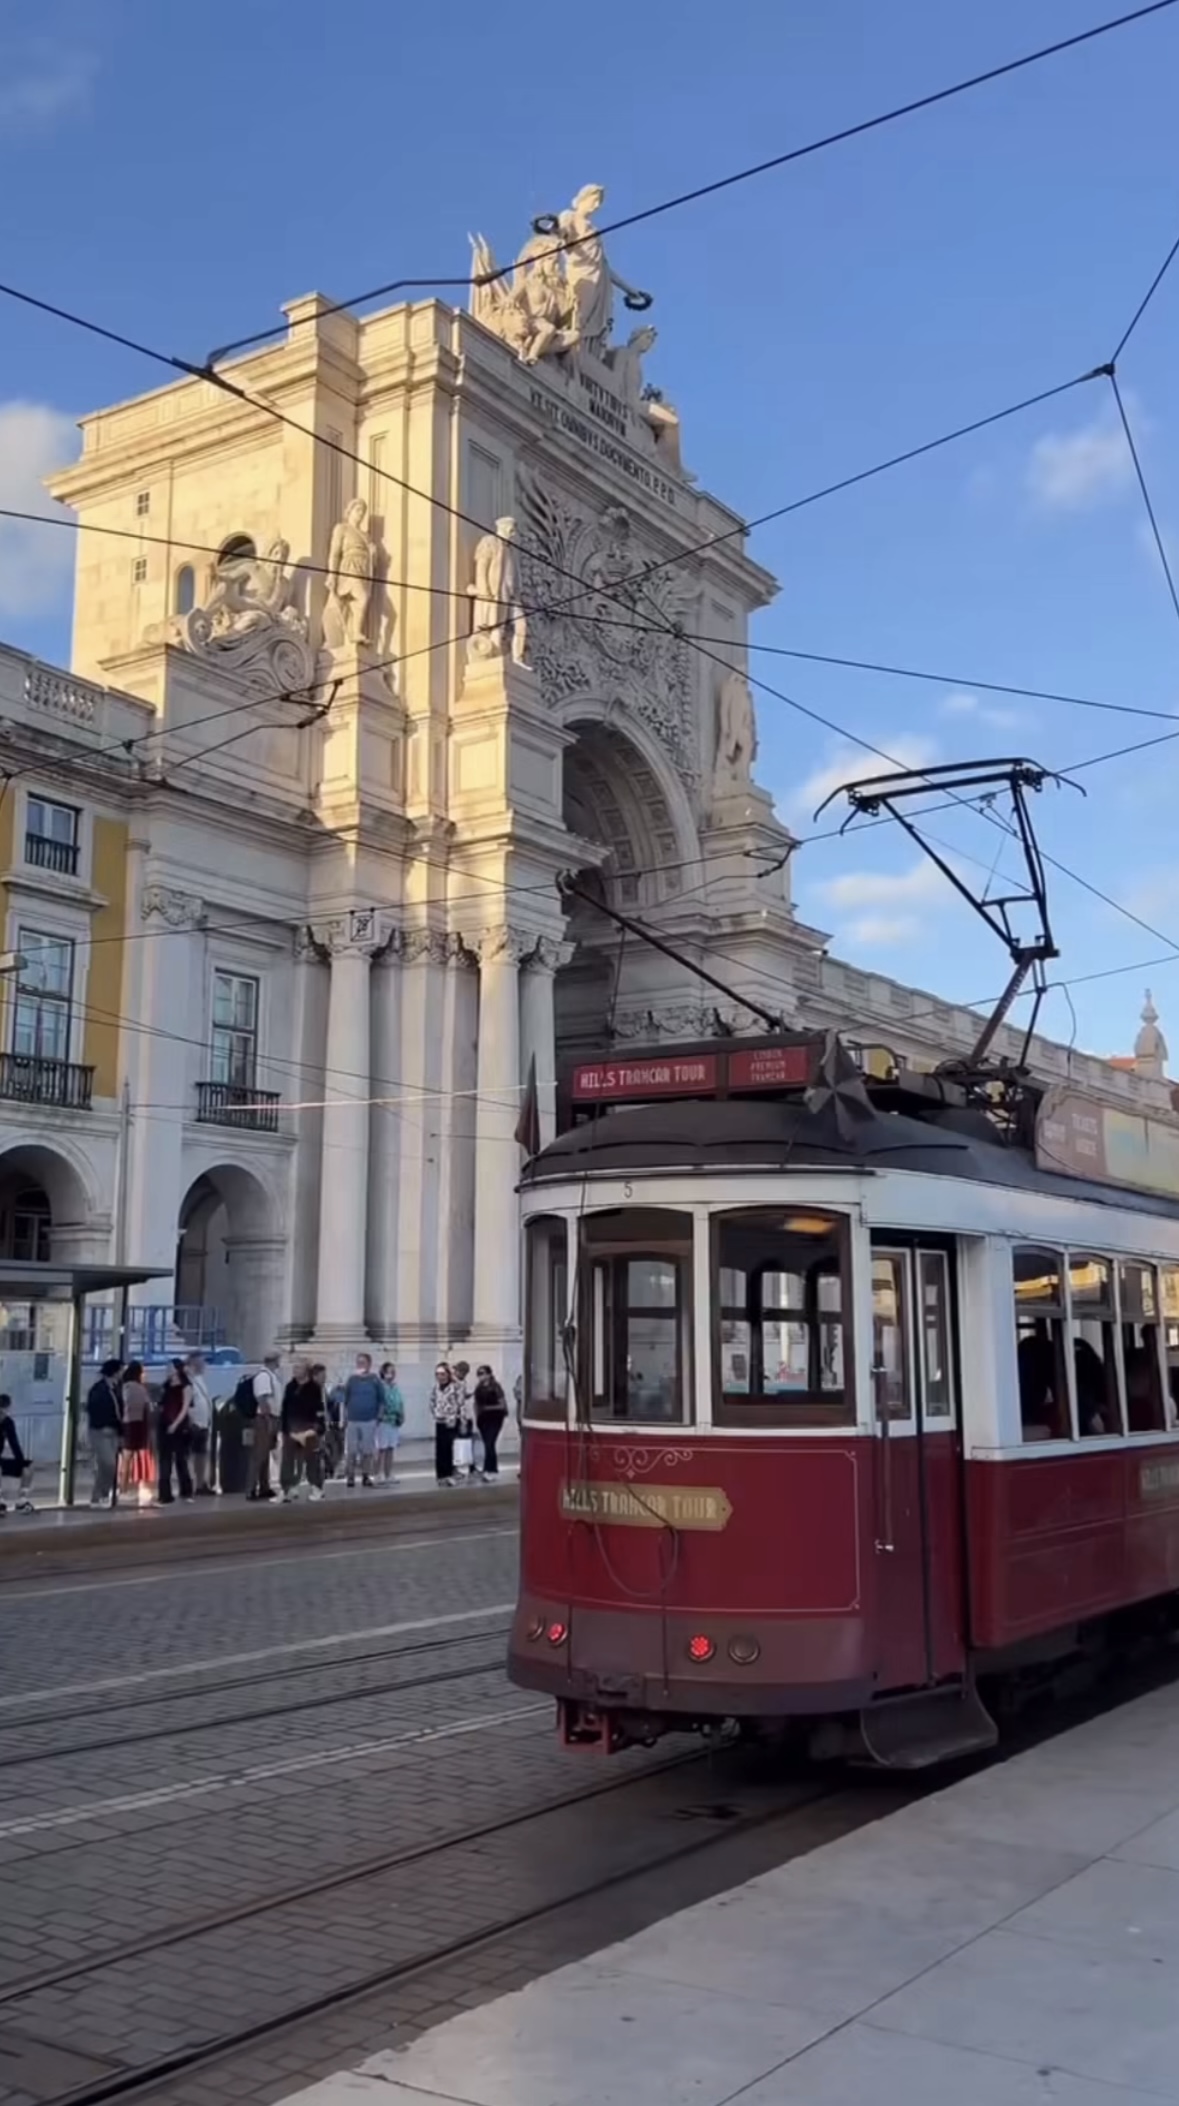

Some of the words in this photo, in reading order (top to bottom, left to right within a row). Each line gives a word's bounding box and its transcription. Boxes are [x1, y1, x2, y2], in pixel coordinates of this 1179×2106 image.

[619, 1066, 671, 1086] TRAMCAR
[673, 1064, 706, 1083] TOUR
[623, 1181, 633, 1199] 5
[602, 1491, 667, 1518] TRAMCAR
[672, 1495, 717, 1519] TOUR
